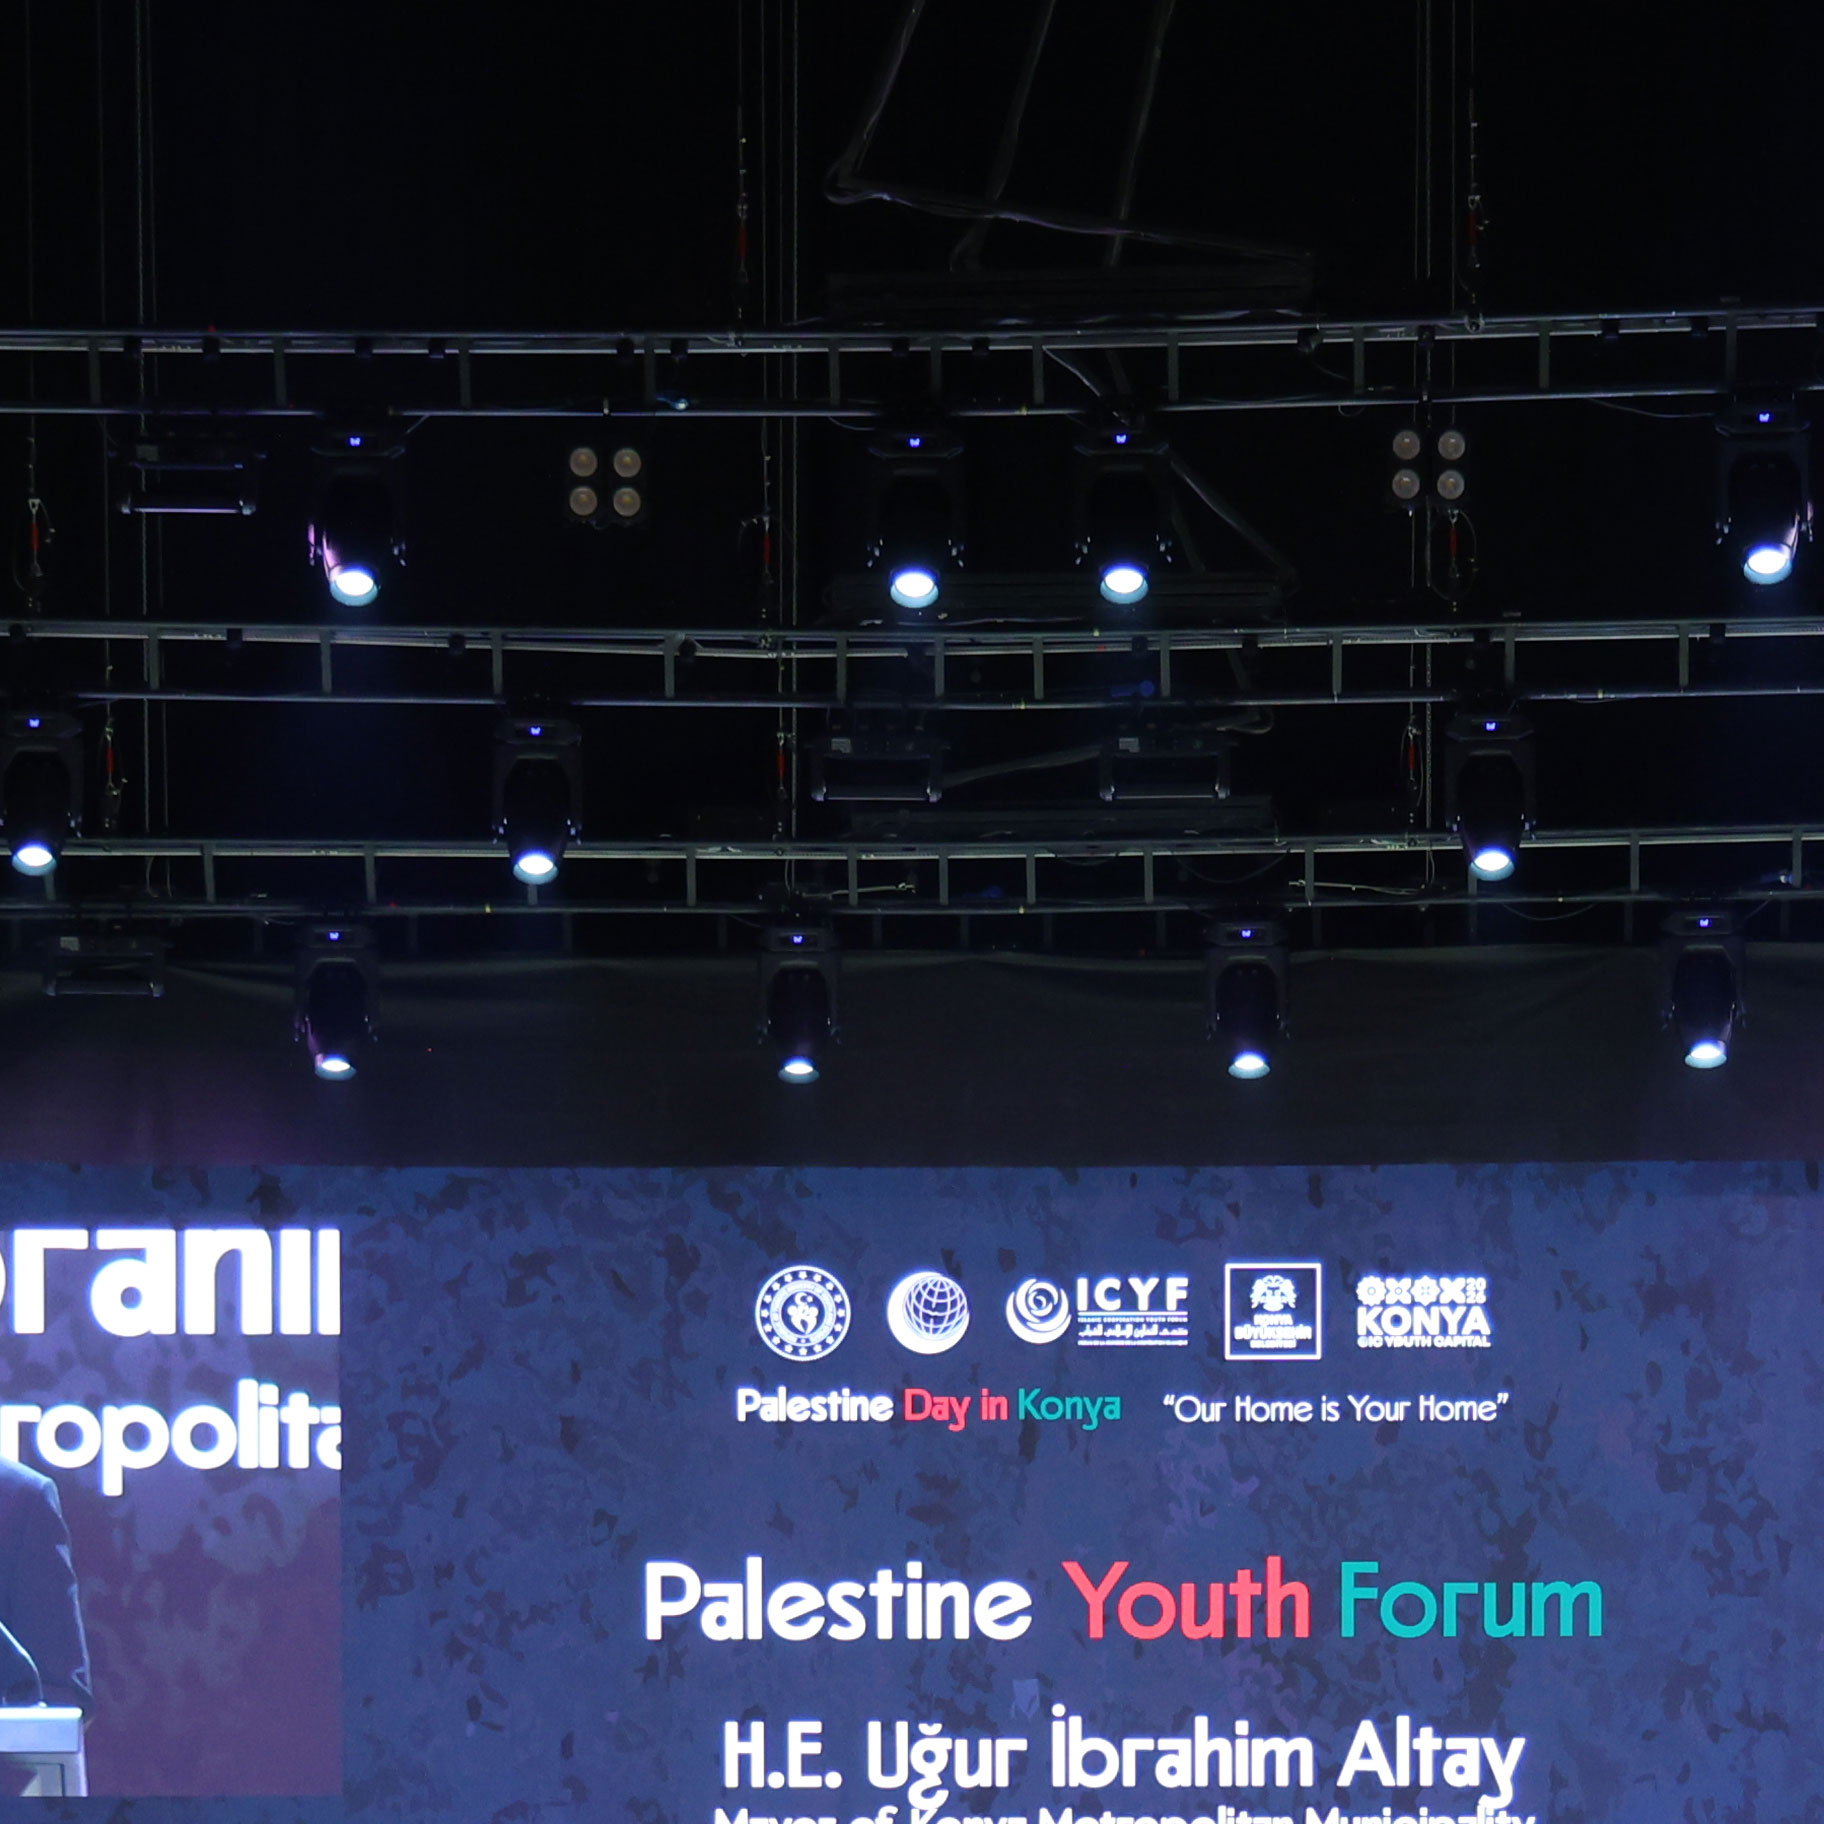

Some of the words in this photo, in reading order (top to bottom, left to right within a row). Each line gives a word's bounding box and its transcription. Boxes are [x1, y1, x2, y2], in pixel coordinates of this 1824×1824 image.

[1076, 1276, 1189, 1312] ICYF
[1466, 1277, 1487, 1290] 20
[1357, 1305, 1492, 1336] KONYA
[1384, 1335, 1432, 1349] YOUTH
[1433, 1335, 1492, 1349] CAPITAL
[736, 1386, 894, 1423] Palestine
[903, 1387, 972, 1432] Day
[980, 1388, 1009, 1421] in
[1018, 1388, 1121, 1431] Konya
[1235, 1395, 1314, 1423] Home
[1321, 1395, 1341, 1422] is
[1347, 1394, 1412, 1422] Your
[645, 1556, 1033, 1642] Palestine
[1061, 1556, 1310, 1640] Youth
[1341, 1561, 1603, 1639] Forum
[724, 1720, 843, 1789] H.E.
[867, 1720, 1028, 1809] Uğur
[1051, 1703, 1314, 1789] İbrahim
[1336, 1714, 1526, 1806] Altay
